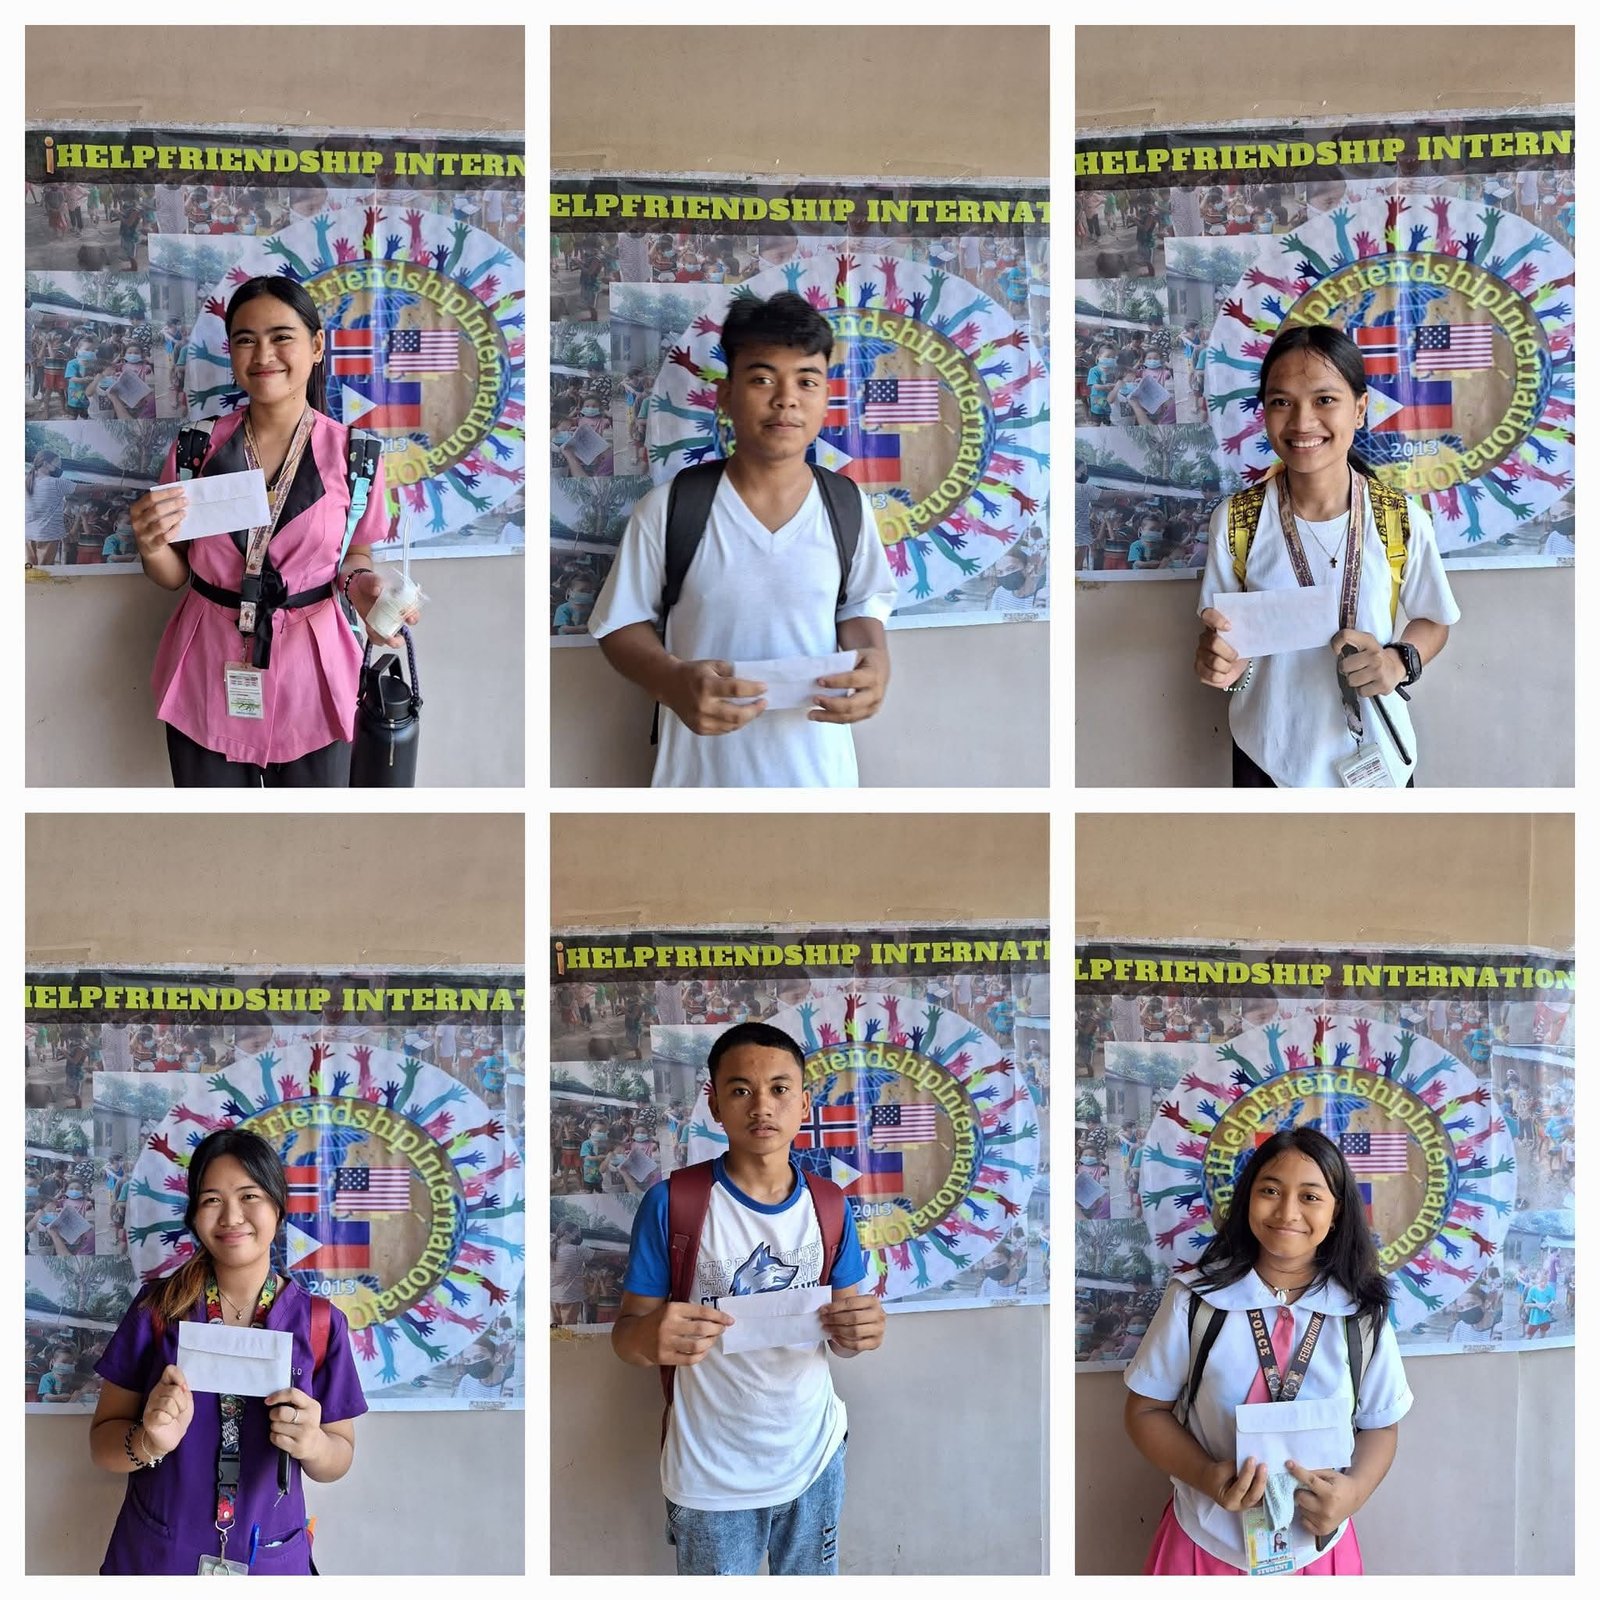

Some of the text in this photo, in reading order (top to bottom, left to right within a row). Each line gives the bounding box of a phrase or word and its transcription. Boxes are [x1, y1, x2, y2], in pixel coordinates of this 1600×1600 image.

[395, 152, 526, 177] INTERN
[1075, 130, 1573, 176] HELPFRIENDSHIP INTERN
[550, 193, 856, 222] ELPFRIENDSHIP
[1390, 440, 1439, 458] 2013
[852, 1202, 892, 1219] 2013
[308, 1278, 356, 1297] 2013
[1250, 1310, 1271, 1356] FORCE
[1298, 1316, 1322, 1363] FEDERATION
